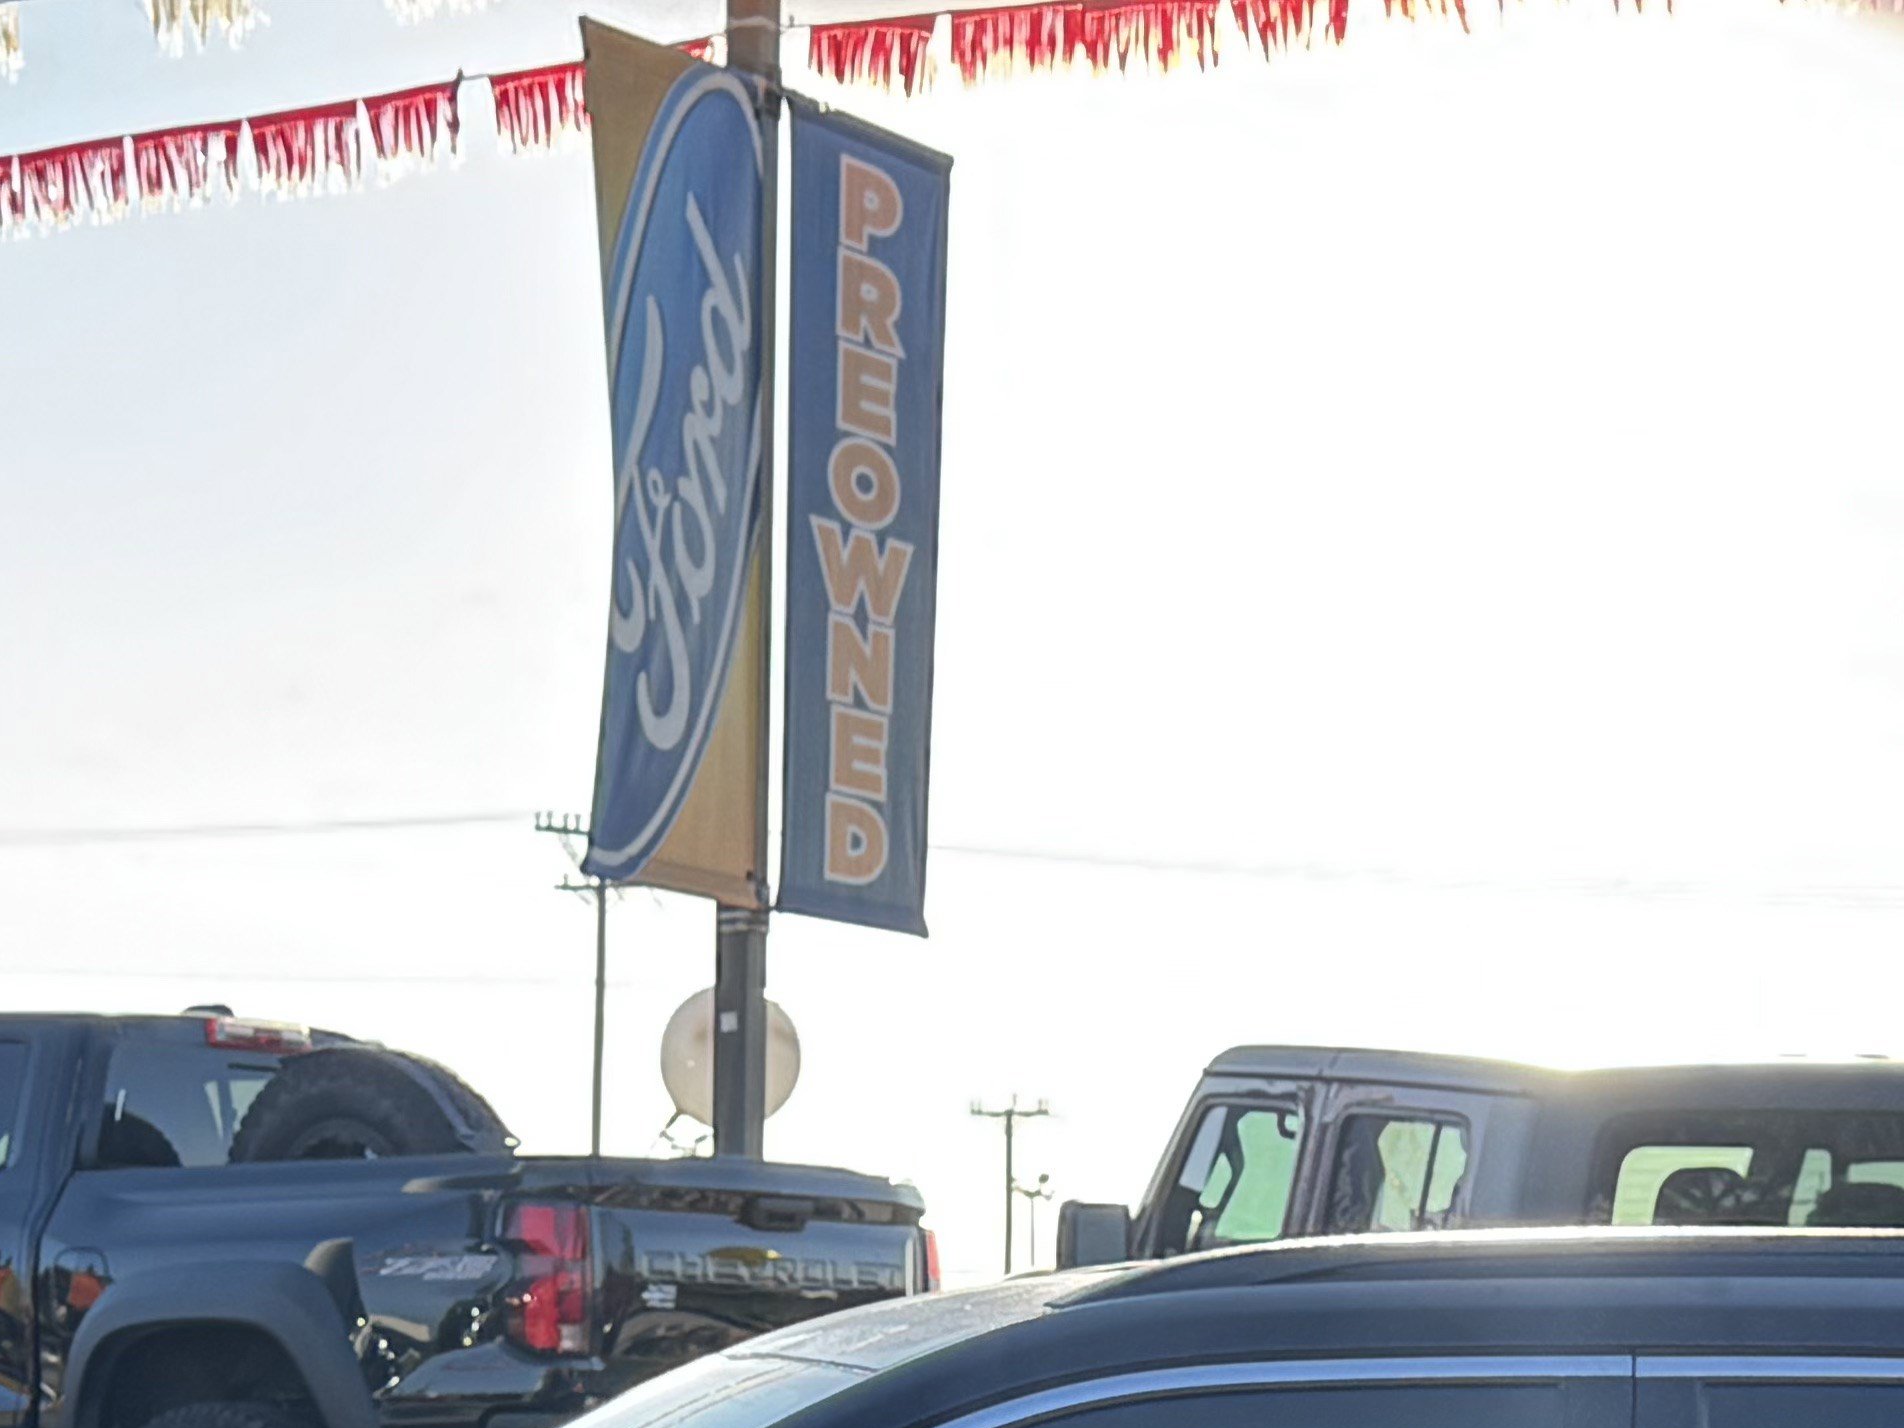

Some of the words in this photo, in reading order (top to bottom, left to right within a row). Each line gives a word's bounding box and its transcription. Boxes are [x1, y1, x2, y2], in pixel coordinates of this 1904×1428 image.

[610, 190, 753, 752] Ford
[809, 152, 914, 887] PREOWNED
[641, 1250, 903, 1289] CHEVROLET
